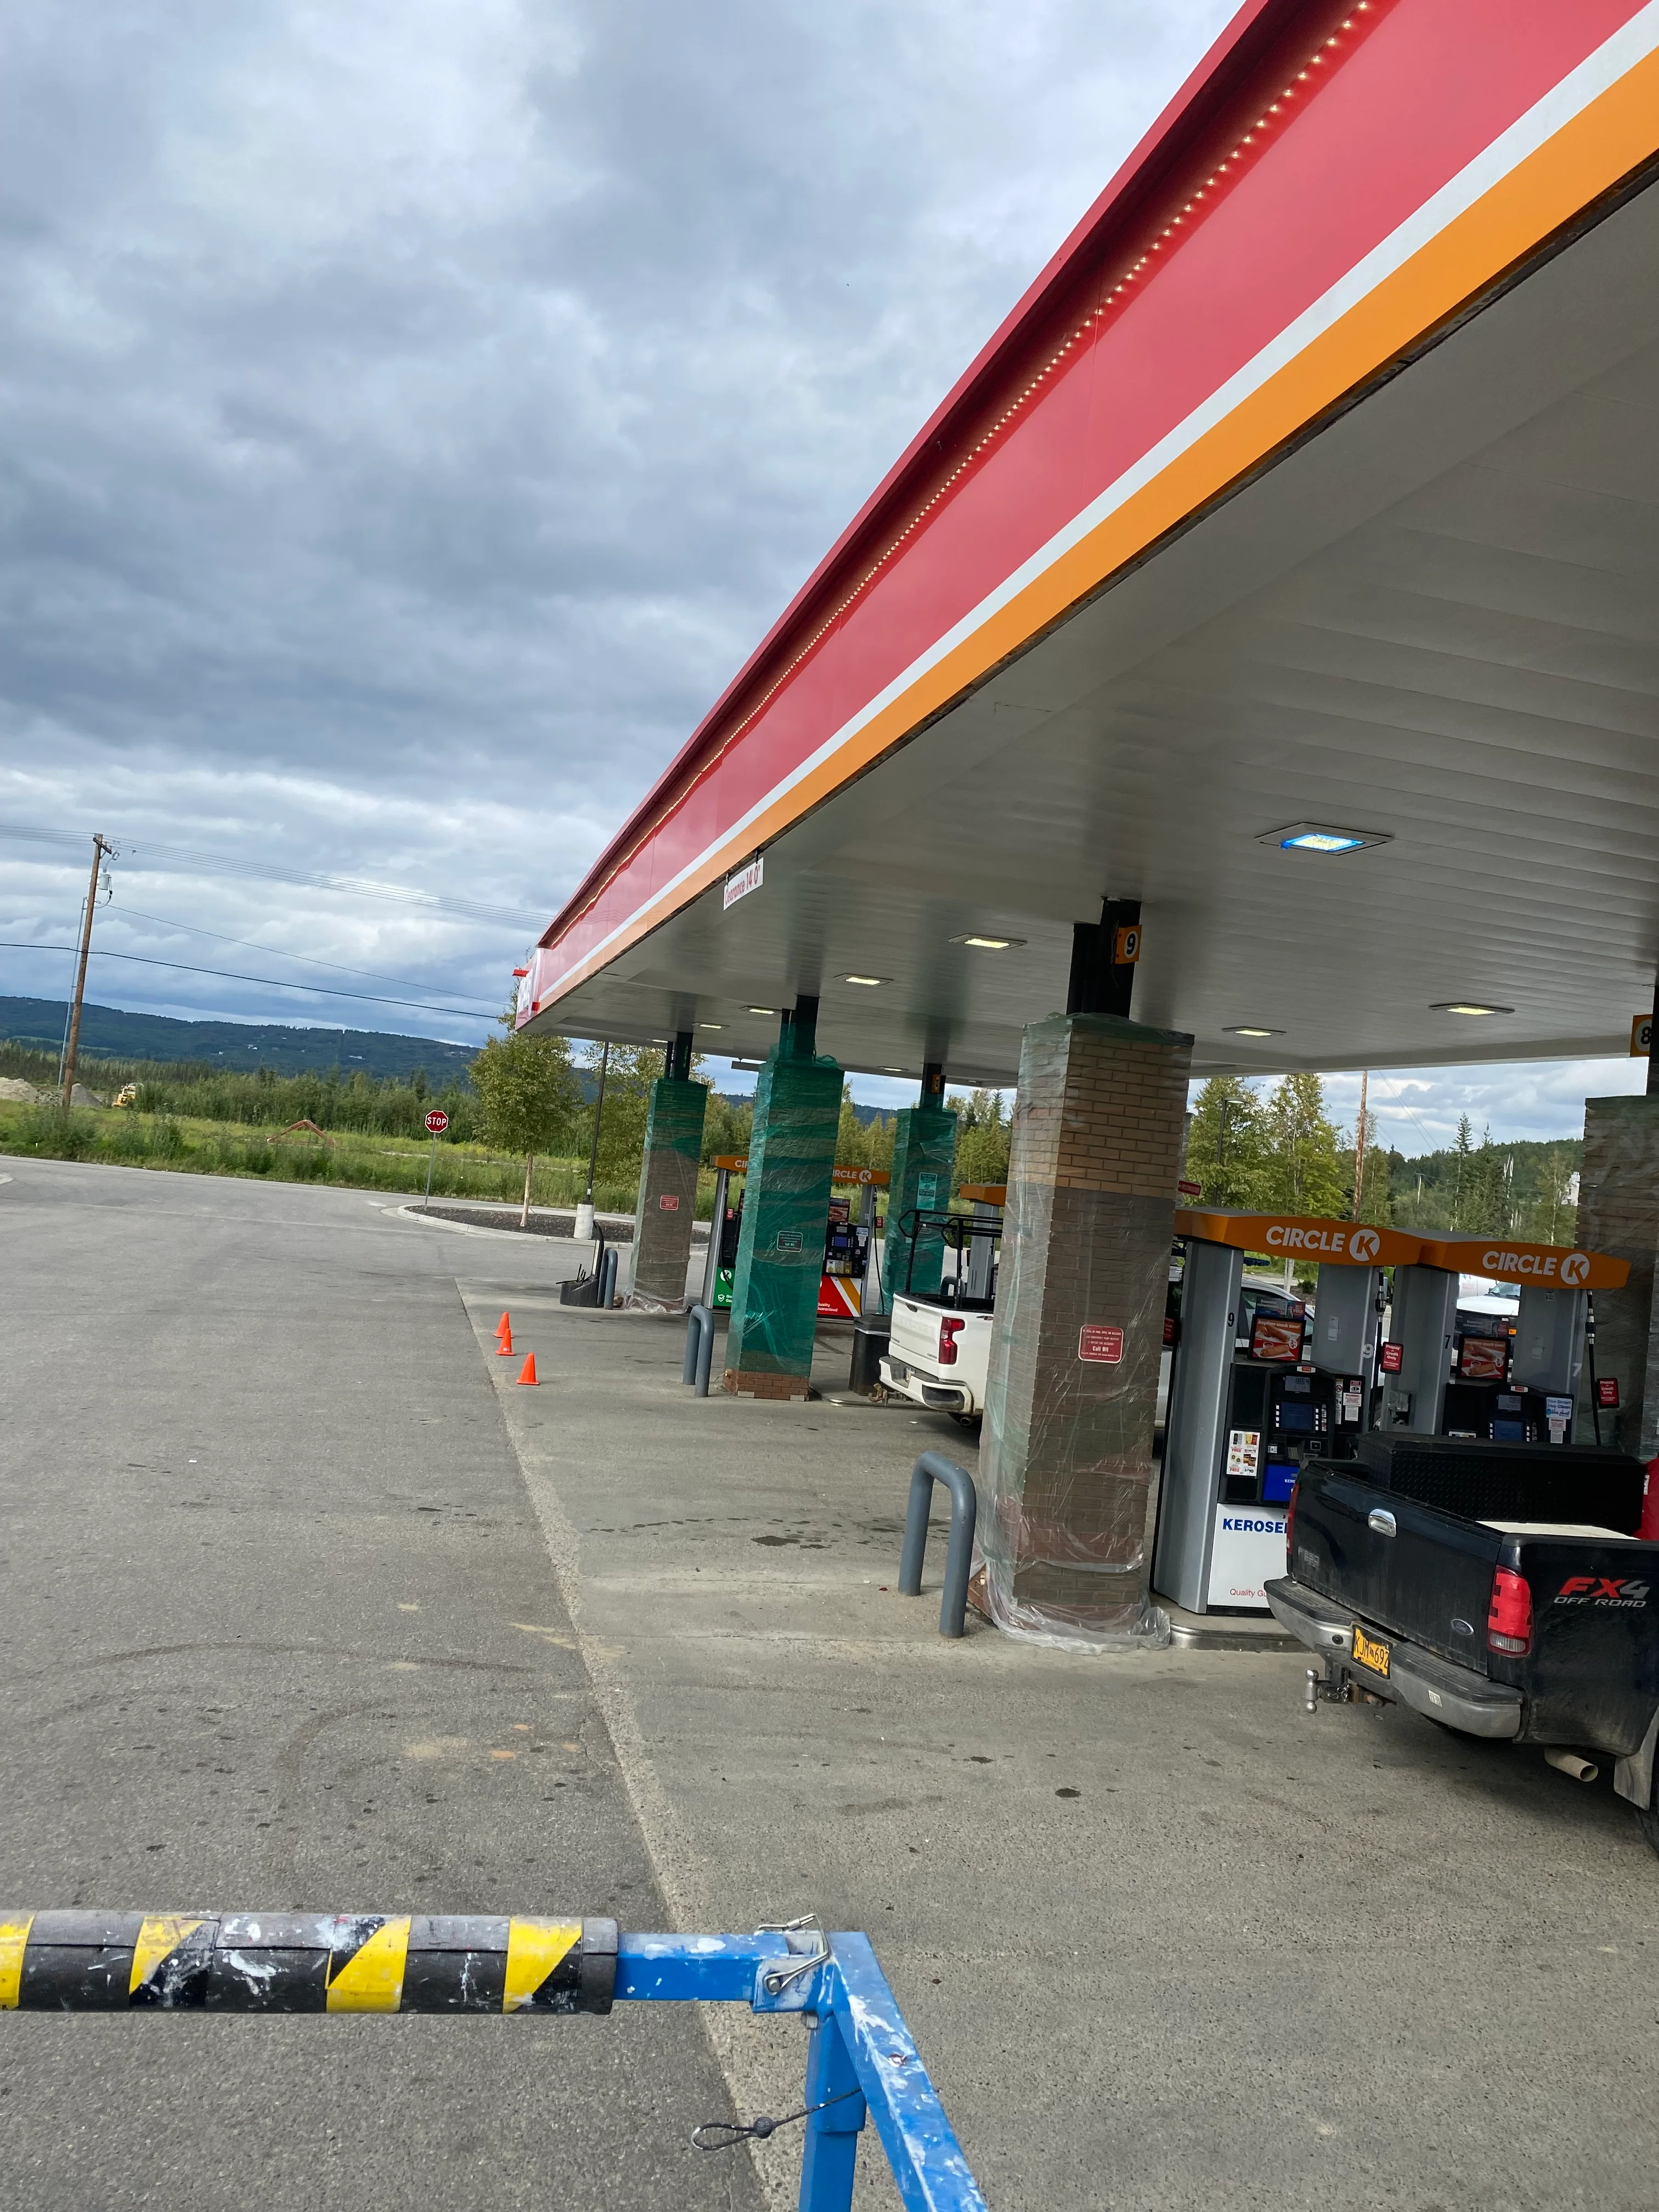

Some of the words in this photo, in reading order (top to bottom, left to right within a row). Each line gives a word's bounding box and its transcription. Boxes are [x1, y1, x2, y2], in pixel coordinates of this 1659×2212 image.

[725, 879, 746, 906] Clearance
[1126, 933, 1136, 955] 9
[1640, 1025, 1651, 1045] 8
[427, 1116, 447, 1126] STOP
[860, 1170, 872, 1182] K
[1266, 1226, 1346, 1252] CIRCLE
[1351, 1231, 1379, 1261] K
[1482, 1250, 1558, 1276] CIRCLE
[1562, 1255, 1588, 1284] K
[1228, 1312, 1235, 1328] 9
[1445, 1335, 1451, 1349] 7
[1363, 1344, 1374, 1359] 9
[1573, 1363, 1582, 1377] 7
[1230, 1588, 1255, 1598] Quality
[1559, 1576, 1650, 1599] FX4
[1594, 1599, 1646, 1607] ROAD
[1355, 1635, 1369, 1658] KJM
